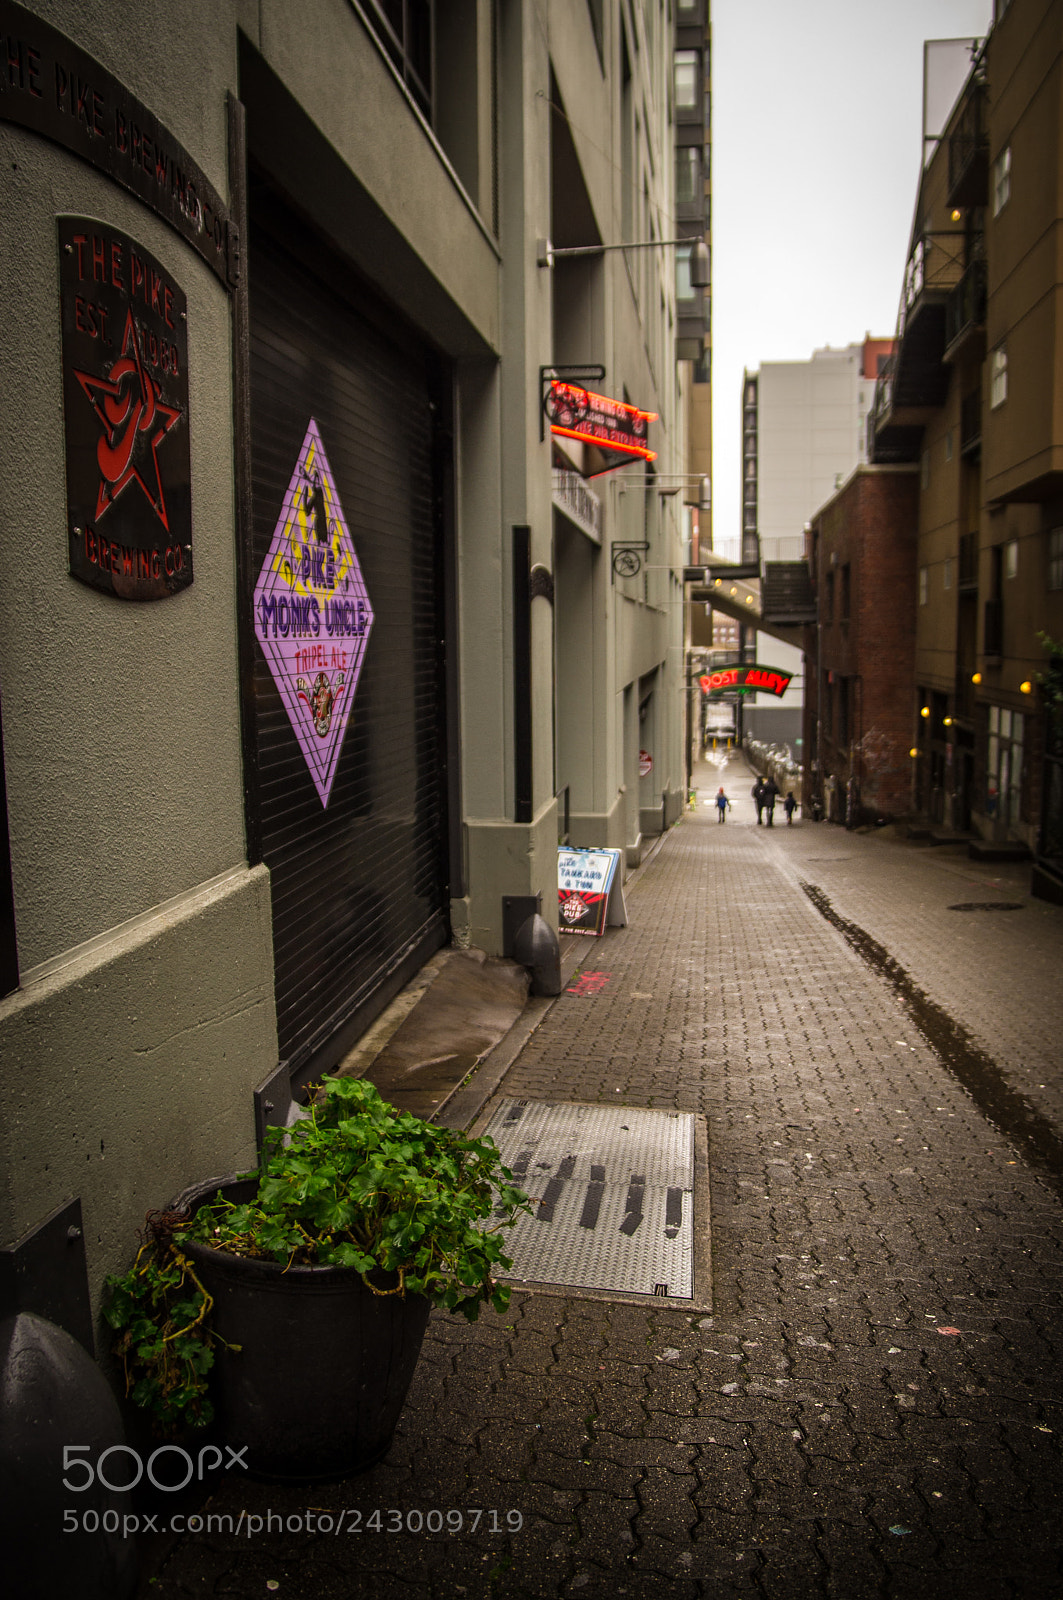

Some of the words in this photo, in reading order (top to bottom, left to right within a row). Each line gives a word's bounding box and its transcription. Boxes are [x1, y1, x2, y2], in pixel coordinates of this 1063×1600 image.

[0, 37, 43, 98] HE
[55, 62, 105, 137] PIKE
[115, 108, 202, 234] BREWING
[73, 234, 123, 289] THE
[131, 252, 174, 330] PIKE
[75, 295, 112, 347] EST.
[142, 329, 179, 376] 1989
[85, 525, 160, 580] BREWING
[301, 544, 335, 589] PIKE
[324, 598, 365, 637] UNCLE
[294, 644, 328, 675] TRIPEL
[330, 646, 347, 672] ALE
[699, 669, 738, 693] POST
[745, 669, 789, 695] ALLEY
